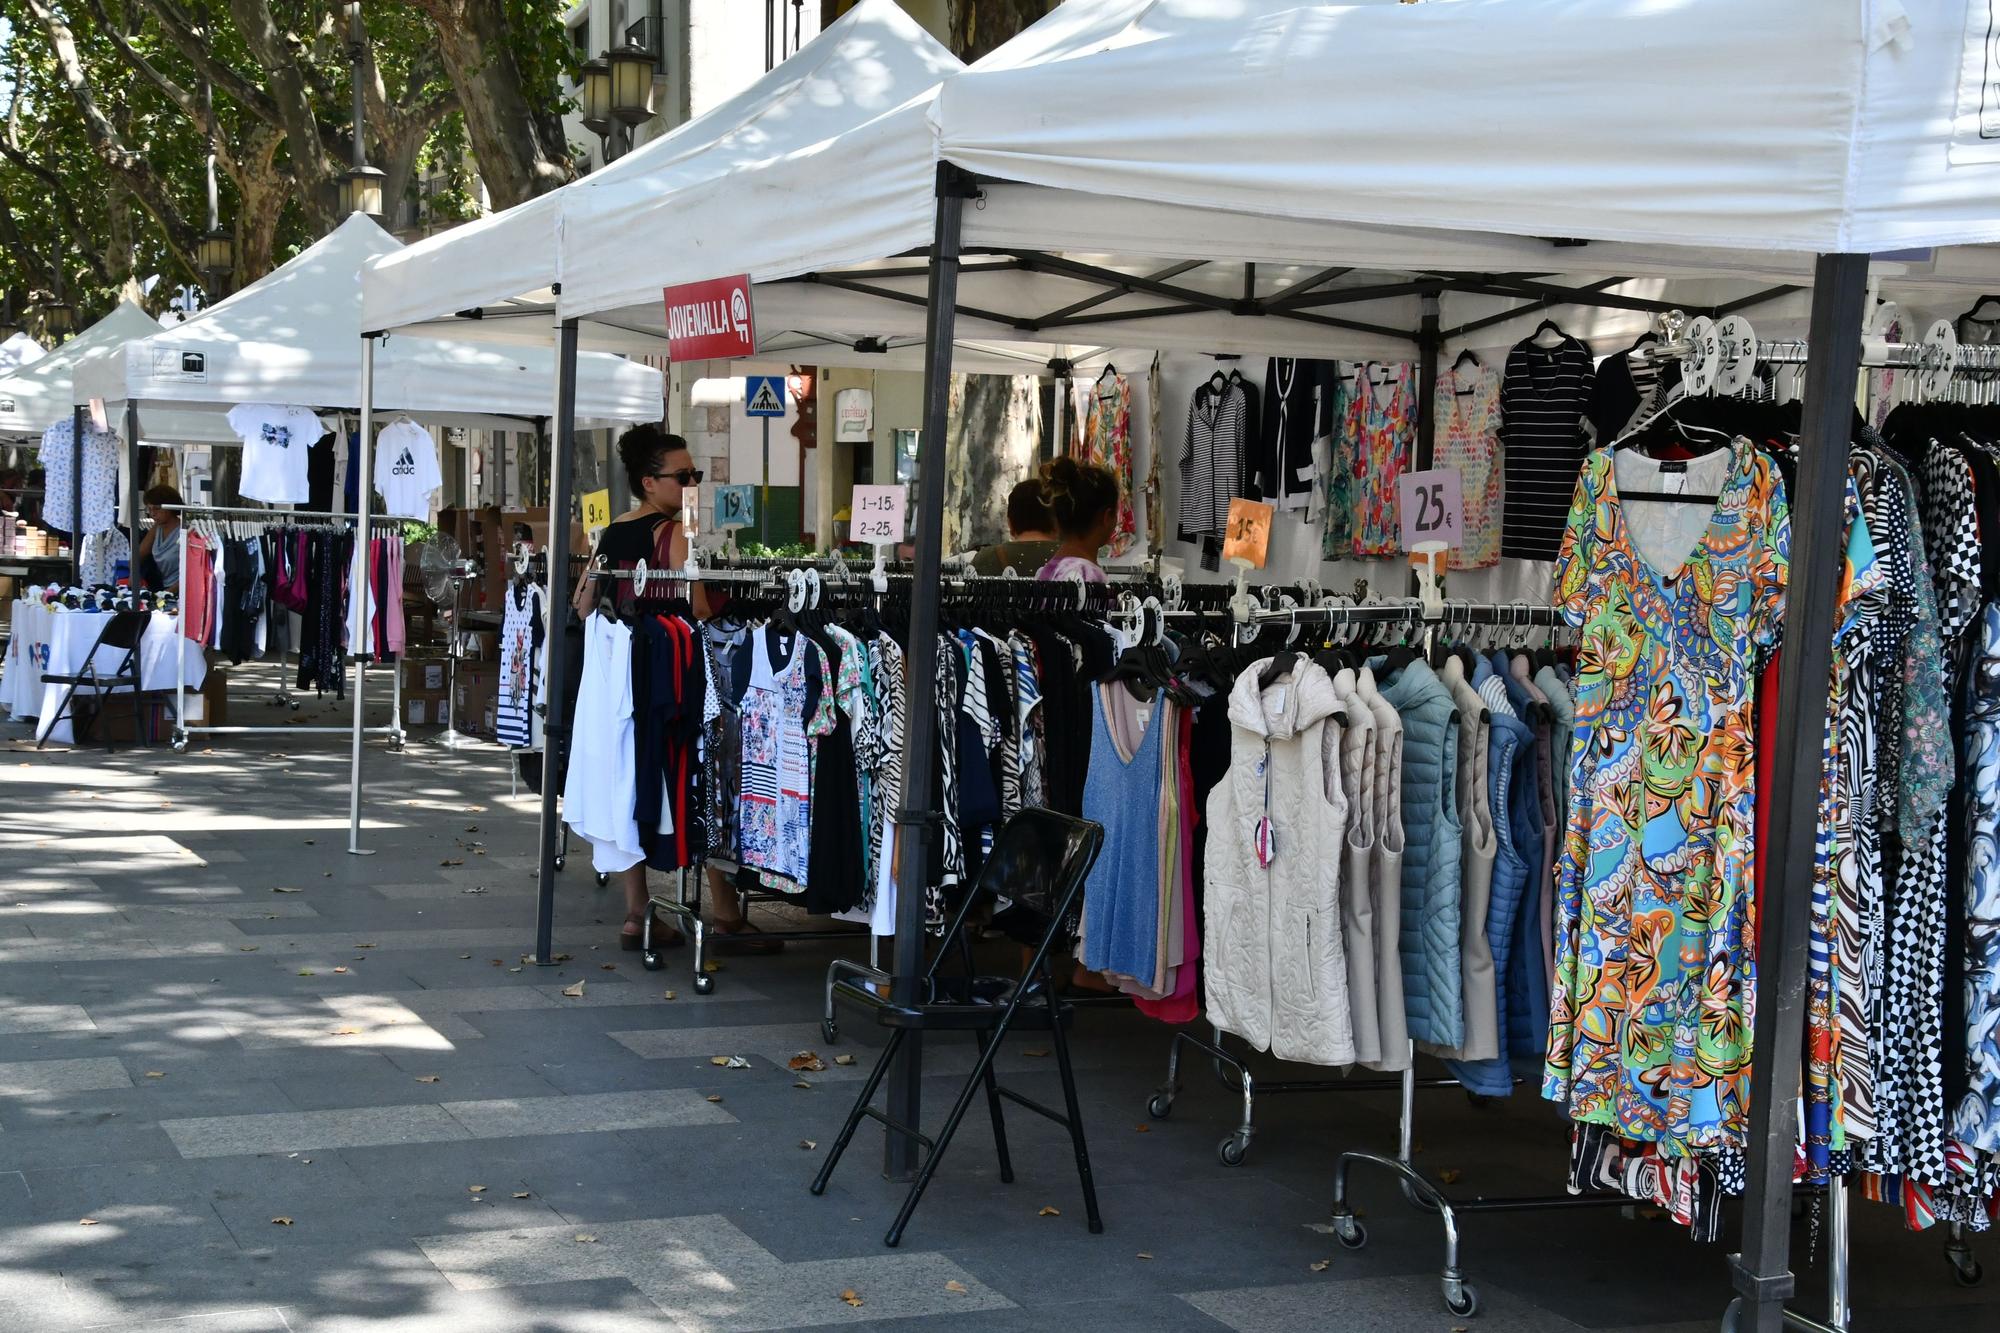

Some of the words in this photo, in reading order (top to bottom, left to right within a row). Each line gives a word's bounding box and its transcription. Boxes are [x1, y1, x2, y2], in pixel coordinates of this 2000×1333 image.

[668, 299, 730, 340] JOVENALLA
[1691, 323, 1701, 339] 40
[1722, 322, 1734, 337] 42
[1742, 338, 1752, 356] 42
